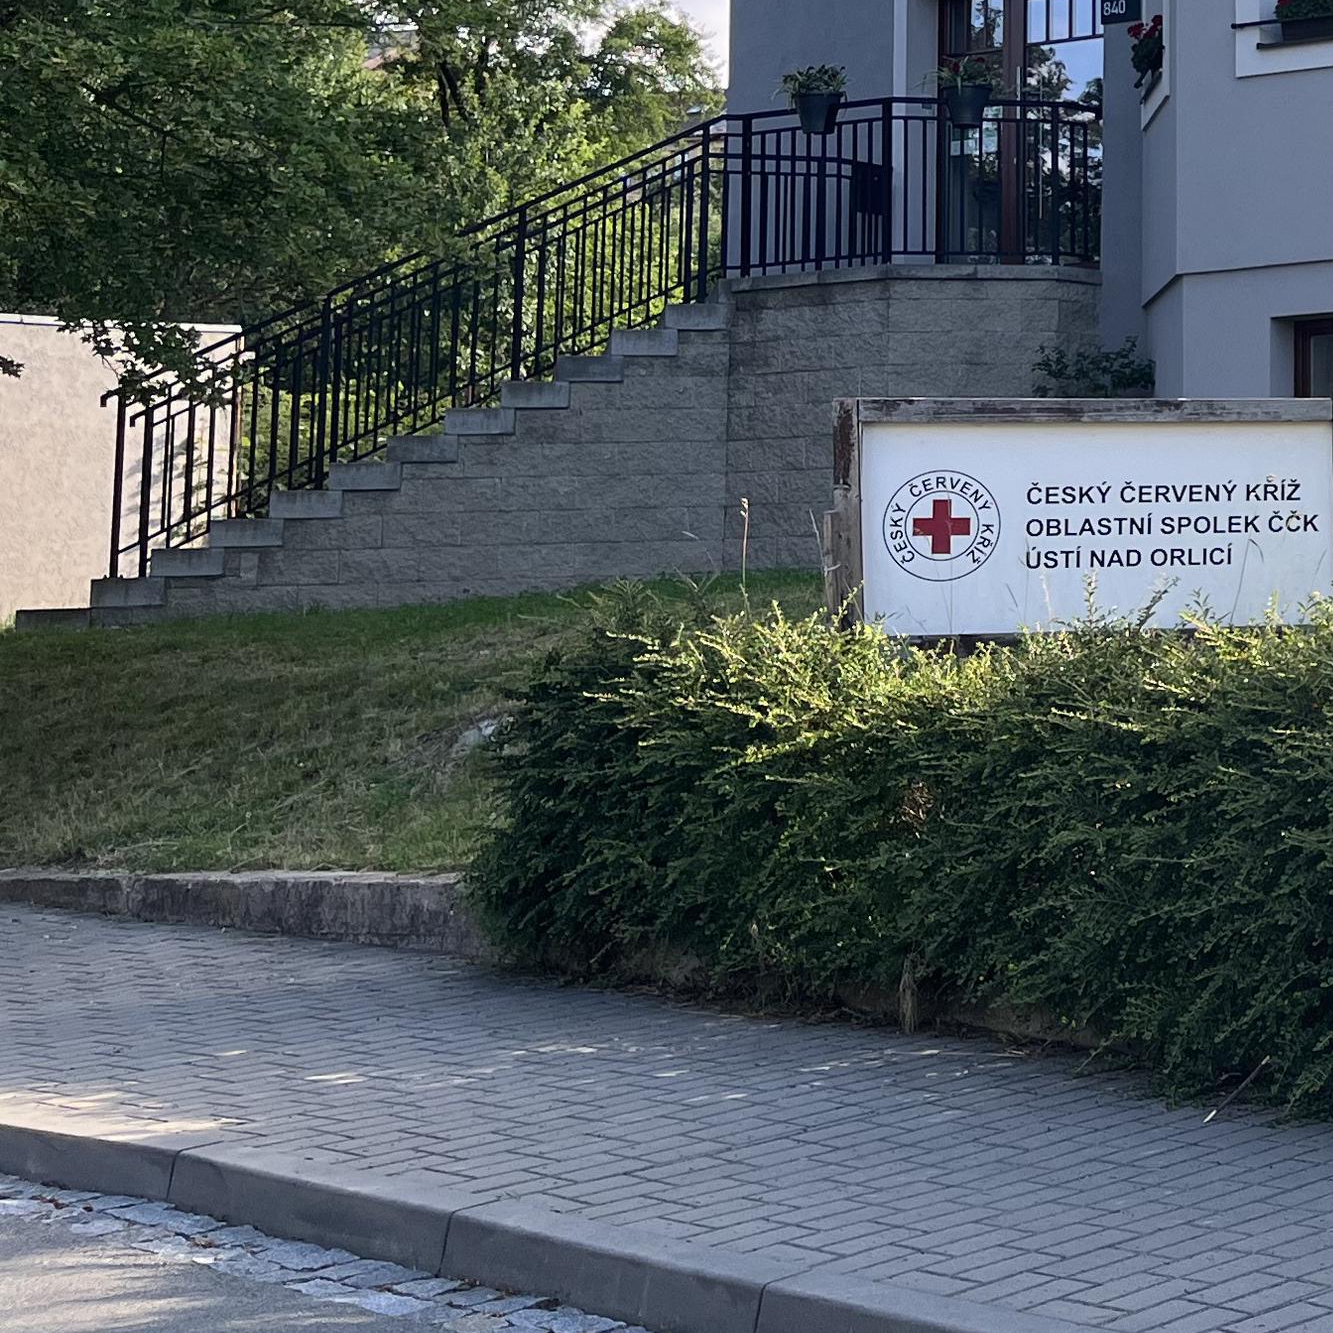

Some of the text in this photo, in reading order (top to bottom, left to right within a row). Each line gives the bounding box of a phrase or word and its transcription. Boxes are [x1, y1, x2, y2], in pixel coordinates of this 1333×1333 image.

[1103, 0, 1126, 16] 840
[1026, 478, 1301, 505] ČESKÝ ČERVENÝ KŘÍŽ
[889, 477, 995, 564] ČESKÝ ČERVENÝ KŘÍŽ
[1025, 510, 1319, 537] OBLASTNÍ SPOLEK ČČK
[1025, 543, 1233, 570] ÚSTÍ NAD ORLICÍ
